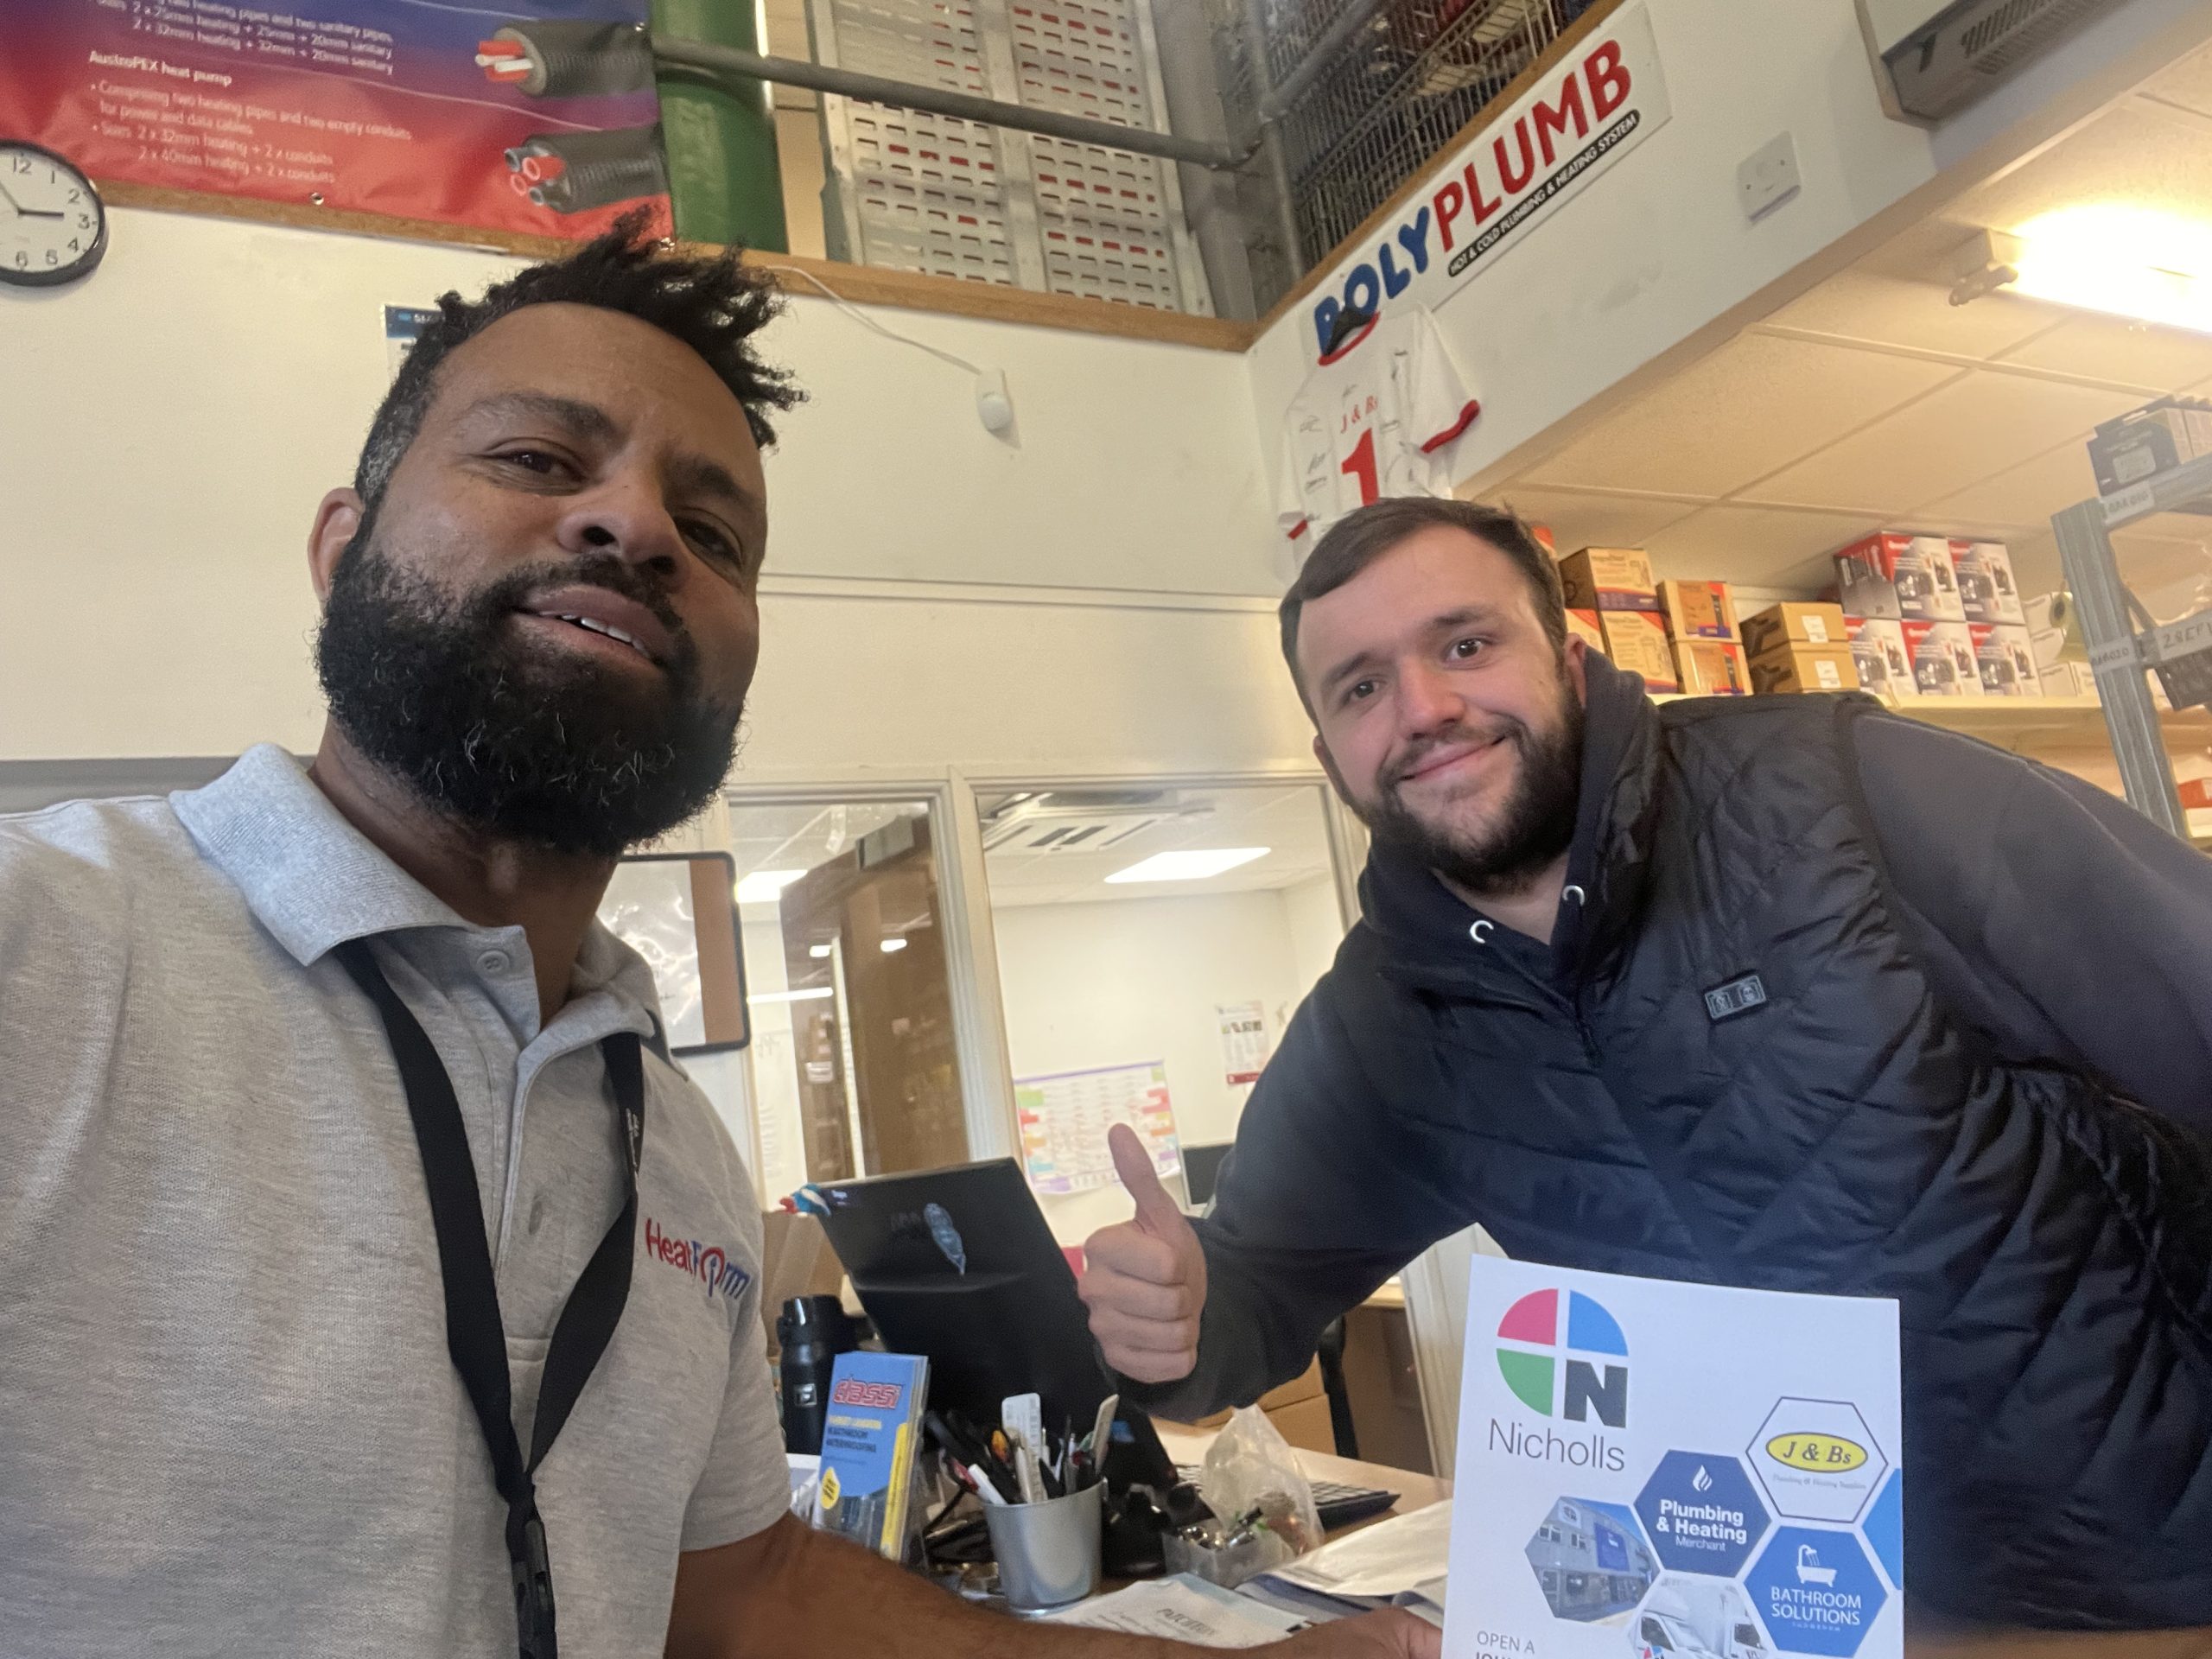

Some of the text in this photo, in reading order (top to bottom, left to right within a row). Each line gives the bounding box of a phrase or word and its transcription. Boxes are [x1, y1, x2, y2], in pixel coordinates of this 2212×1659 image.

[197, 31, 241, 51] heating
[89, 50, 232, 87] AustroPEX heat pump
[99, 79, 170, 107] Comprising
[198, 94, 244, 118] heating
[203, 132, 248, 158] heating
[13, 156, 32, 175] 12
[205, 154, 250, 175] heating
[50, 170, 56, 184] 1
[1469, 246, 1477, 259] &
[1476, 226, 1501, 251] COLD
[1500, 189, 1547, 234] PLUMBING
[1546, 182, 1556, 196] &
[1554, 146, 1598, 188] HEATING
[1598, 113, 1637, 151] SYSTEM
[67, 188, 80, 204] 2
[78, 213, 91, 230] 3
[45, 249, 59, 265] 5
[67, 237, 79, 253] 4
[15, 250, 29, 268] 6
[1341, 427, 1380, 508] 1
[1563, 1358, 1629, 1429] N
[1489, 1417, 1625, 1472] Nicholls
[1783, 1440, 1852, 1464] J & Bs
[1660, 1498, 1744, 1528] Plumbing
[1656, 1516, 1747, 1546] & Heating
[1675, 1535, 1726, 1553] Merchant
[1770, 1586, 1862, 1610] BATHROOM
[1770, 1602, 1861, 1625] SOLUTIONS
[1477, 1630, 1535, 1655] OPEN A
